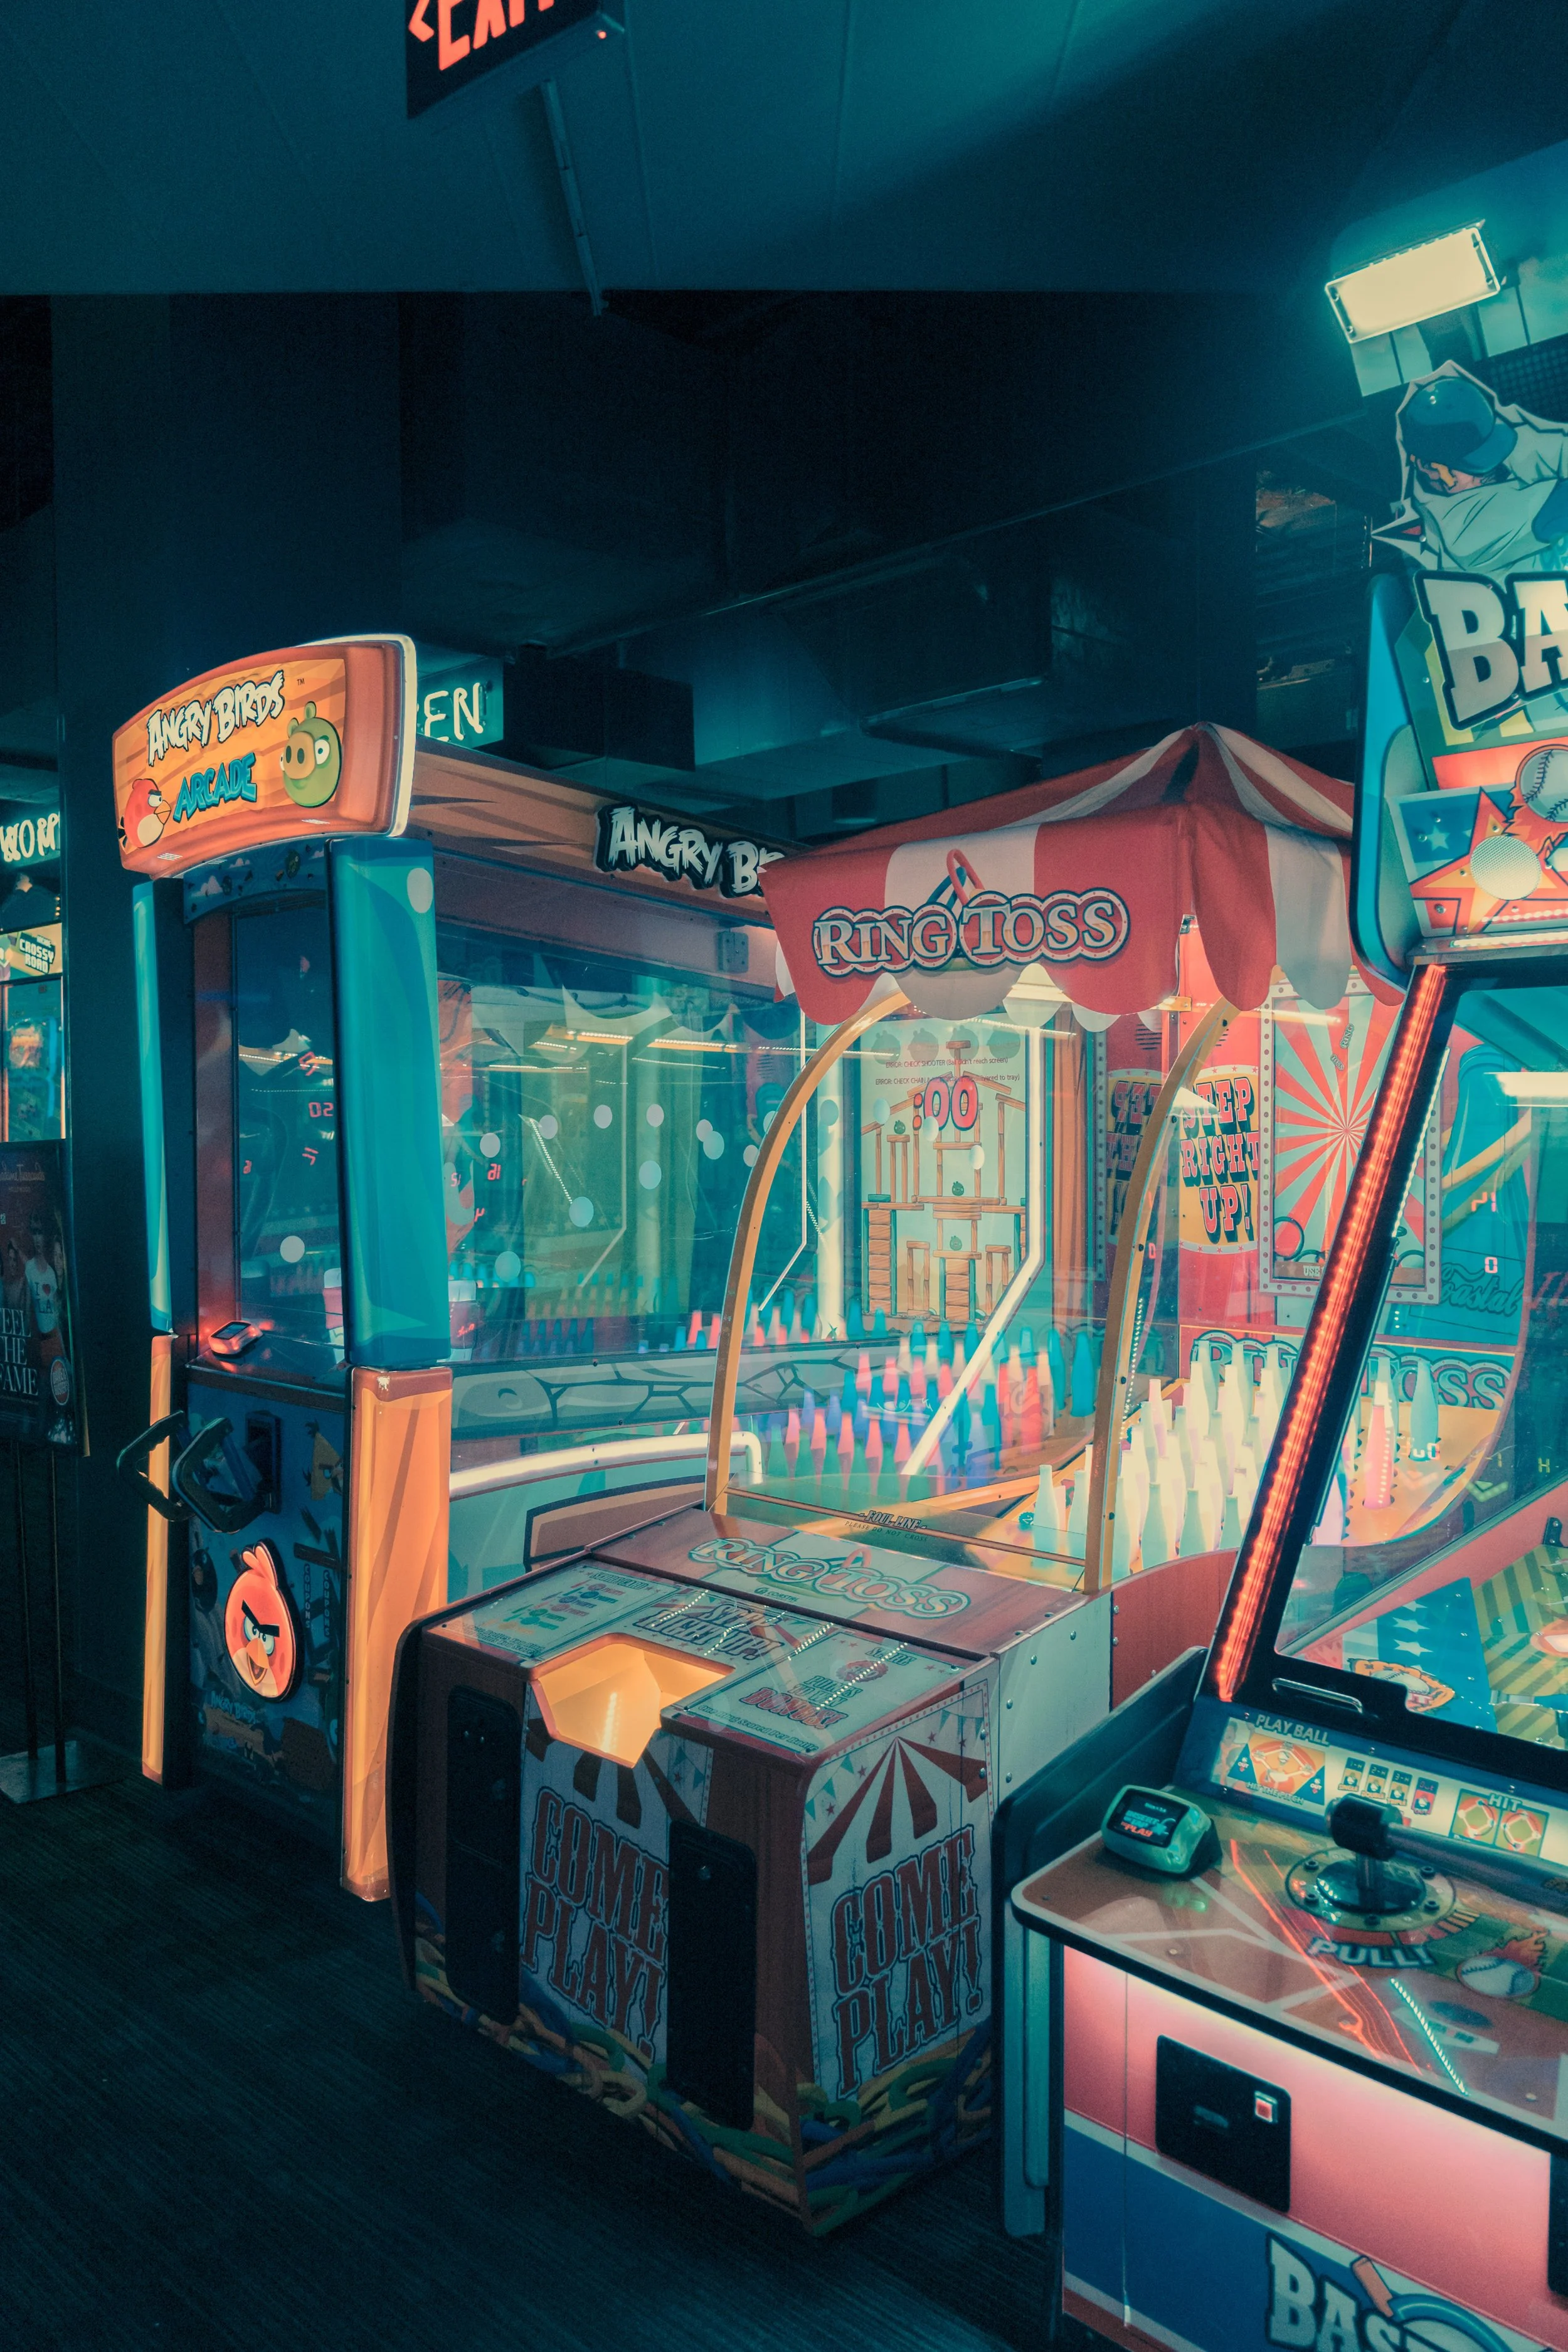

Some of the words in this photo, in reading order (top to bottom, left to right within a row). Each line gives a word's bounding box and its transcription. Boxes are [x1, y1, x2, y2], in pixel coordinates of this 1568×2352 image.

[147, 699, 212, 767] ANGRY
[213, 669, 285, 743] BIRDS
[417, 682, 484, 741] EN
[173, 752, 257, 822] ARCADE
[608, 805, 724, 884] ANGRY
[19, 938, 55, 965] CROSSY
[815, 914, 951, 967] RING
[961, 899, 1116, 958] TOSS
[25, 953, 49, 975] ROAD
[1182, 1077, 1254, 1135] STEP
[1180, 1131, 1259, 1183] RIGHT
[1199, 1183, 1254, 1239] UP!
[0, 1308, 31, 1337] EEL
[845, 1520, 870, 1531] PLEASE
[904, 1533, 929, 1542] CROSS
[866, 1510, 894, 1525] FOUL
[893, 1515, 921, 1530] LINE
[691, 1540, 820, 1579] RING
[821, 1568, 960, 1615] TOSS
[739, 1687, 849, 1730] BONUS!
[1255, 1714, 1293, 1738] PLAY
[1293, 1724, 1330, 1746] BALL
[1488, 1793, 1522, 1812] HIT
[531, 1786, 669, 1965] COME
[832, 1825, 978, 1991] COME
[521, 1872, 668, 2061] PLAY!
[1310, 1938, 1436, 1968] PULL!
[831, 1920, 984, 2100] PLAY!
